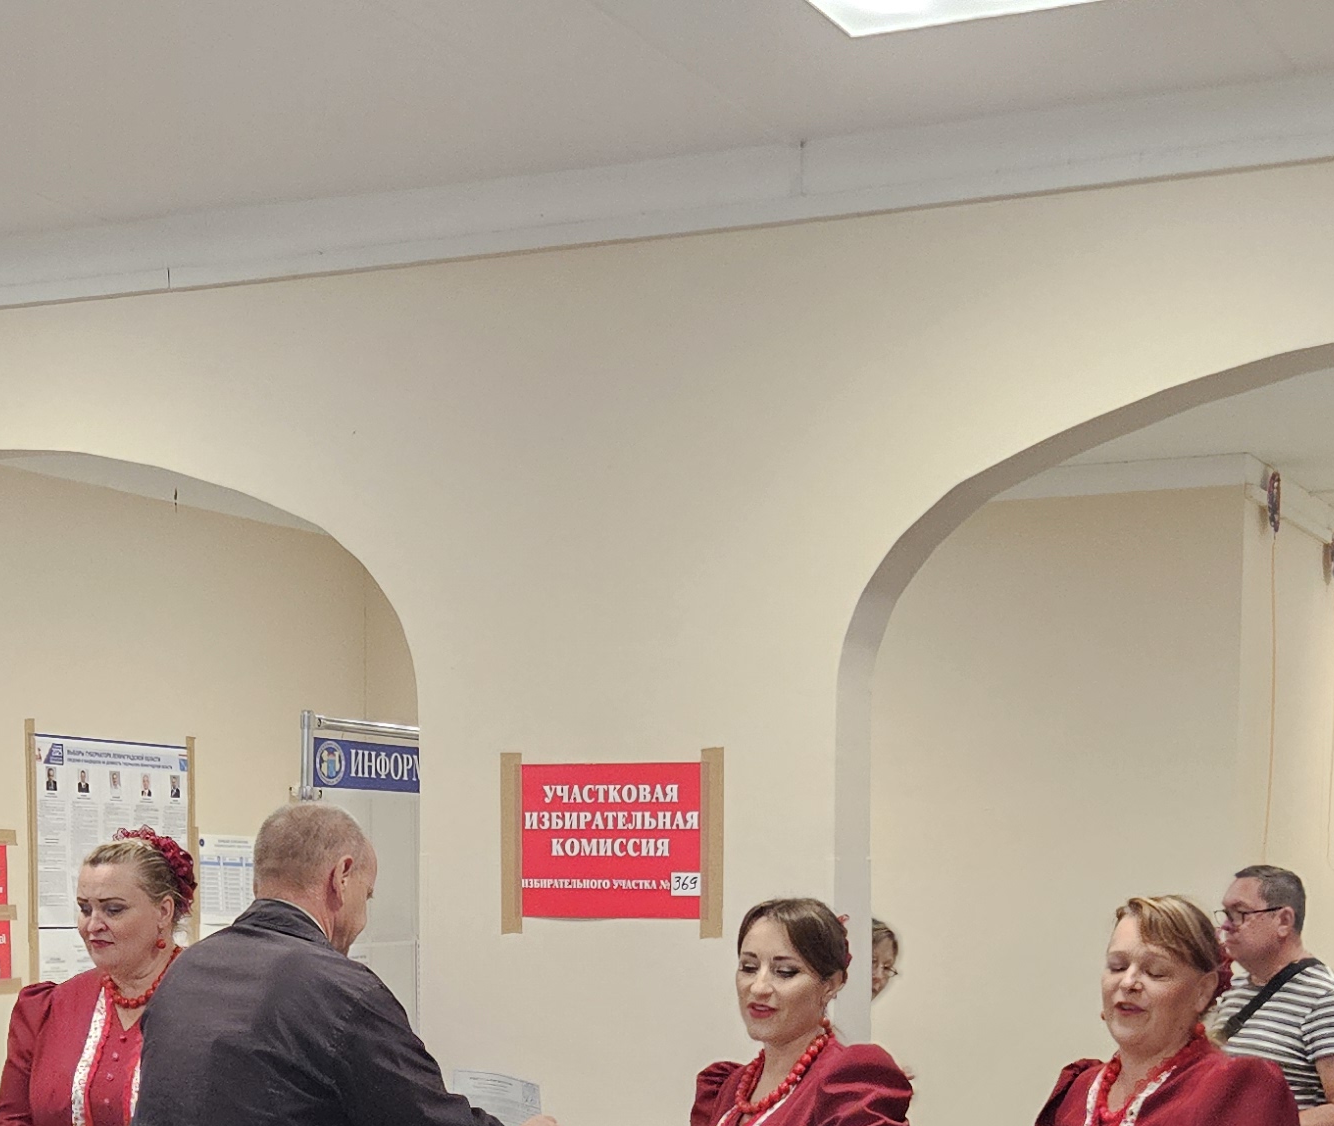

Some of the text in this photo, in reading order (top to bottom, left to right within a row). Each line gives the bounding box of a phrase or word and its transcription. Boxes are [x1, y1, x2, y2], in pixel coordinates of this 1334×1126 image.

[544, 785, 678, 803] УЧАСТКОВАЯ
[525, 812, 699, 830] ИЗБИРАТЕЛЬНАЯ
[551, 838, 670, 857] КОМИССИЯ
[612, 878, 657, 891] УЧАСТКА
[673, 876, 698, 891] 369
